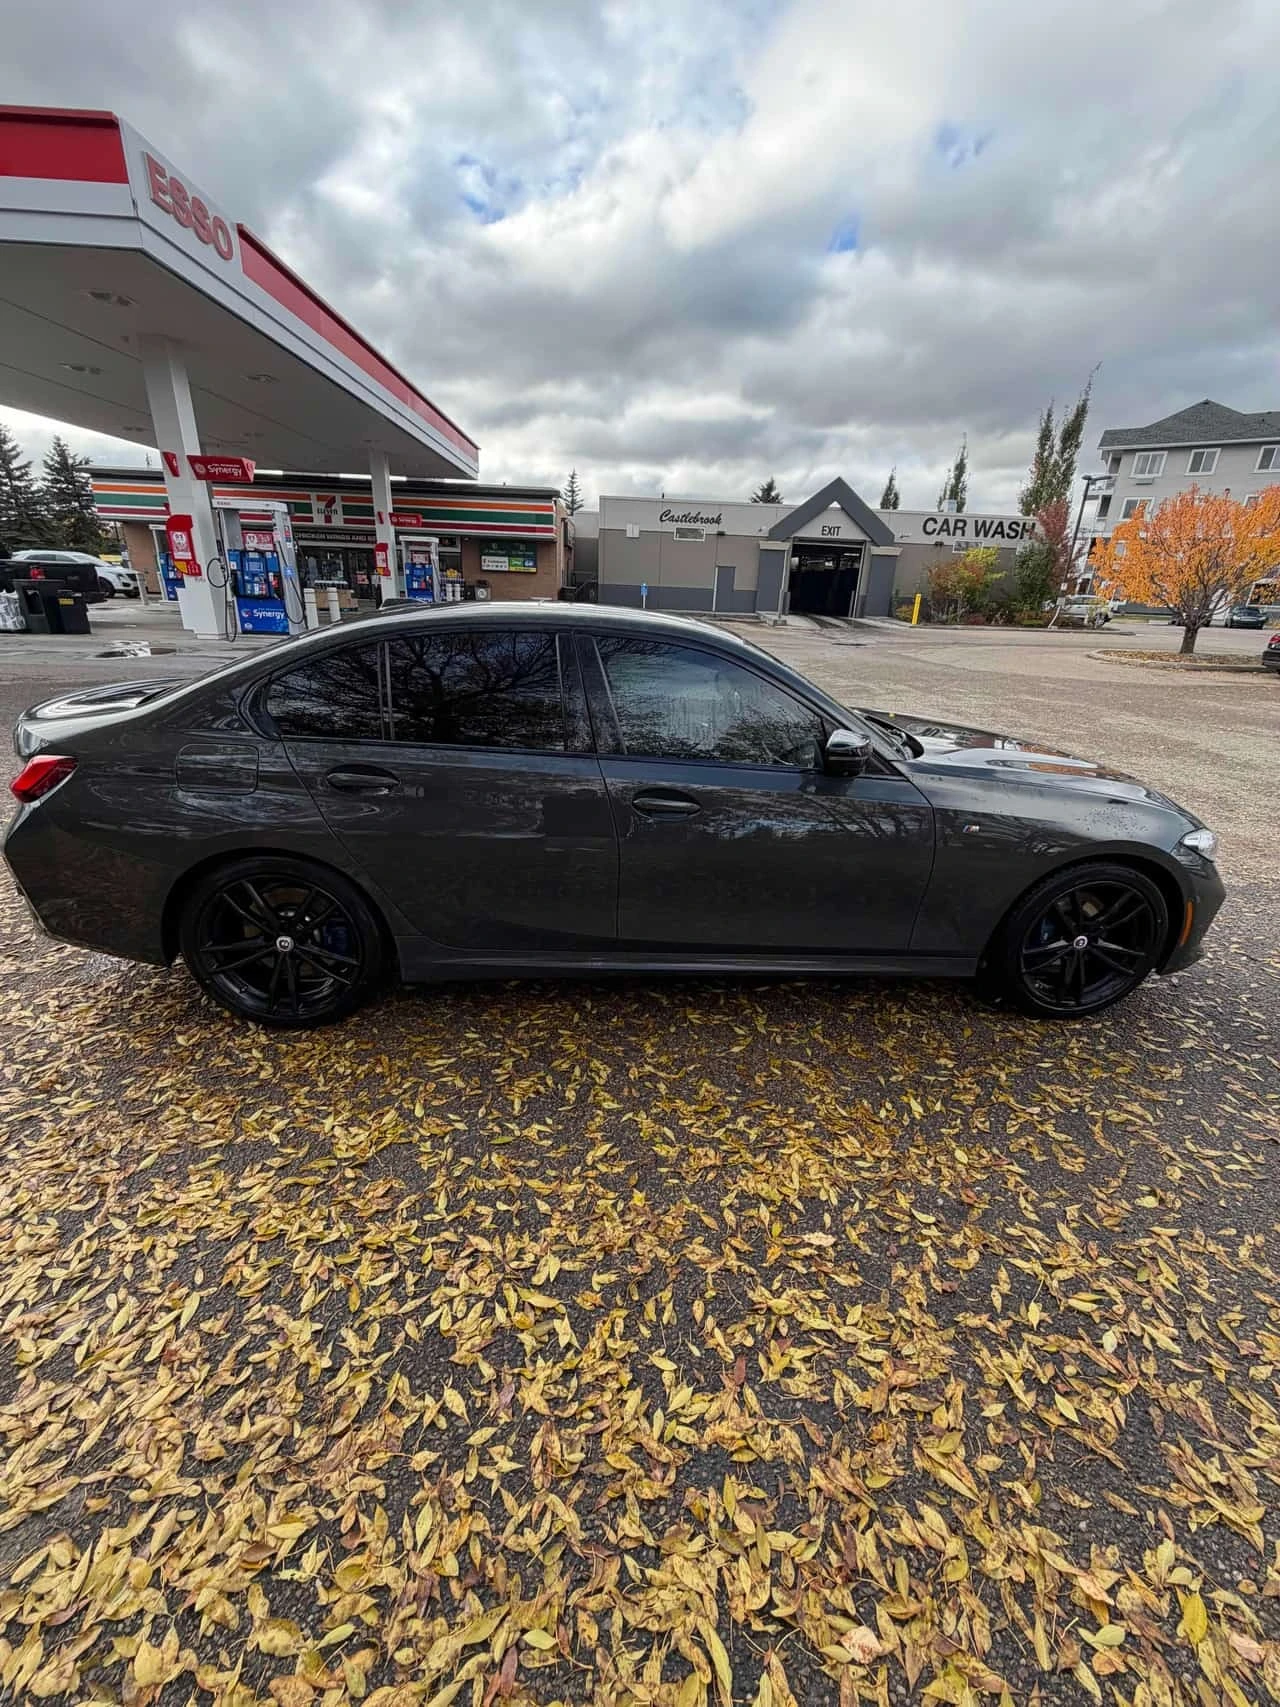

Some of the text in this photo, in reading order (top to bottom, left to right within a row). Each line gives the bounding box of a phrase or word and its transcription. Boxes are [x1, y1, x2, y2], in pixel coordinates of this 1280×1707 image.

[146, 151, 233, 261] ESSO
[207, 464, 241, 478] Synergy
[659, 508, 722, 525] Castlebrook
[821, 525, 842, 537] EXIT
[922, 517, 1036, 540] CAR WASH
[253, 608, 285, 619] Synergy
